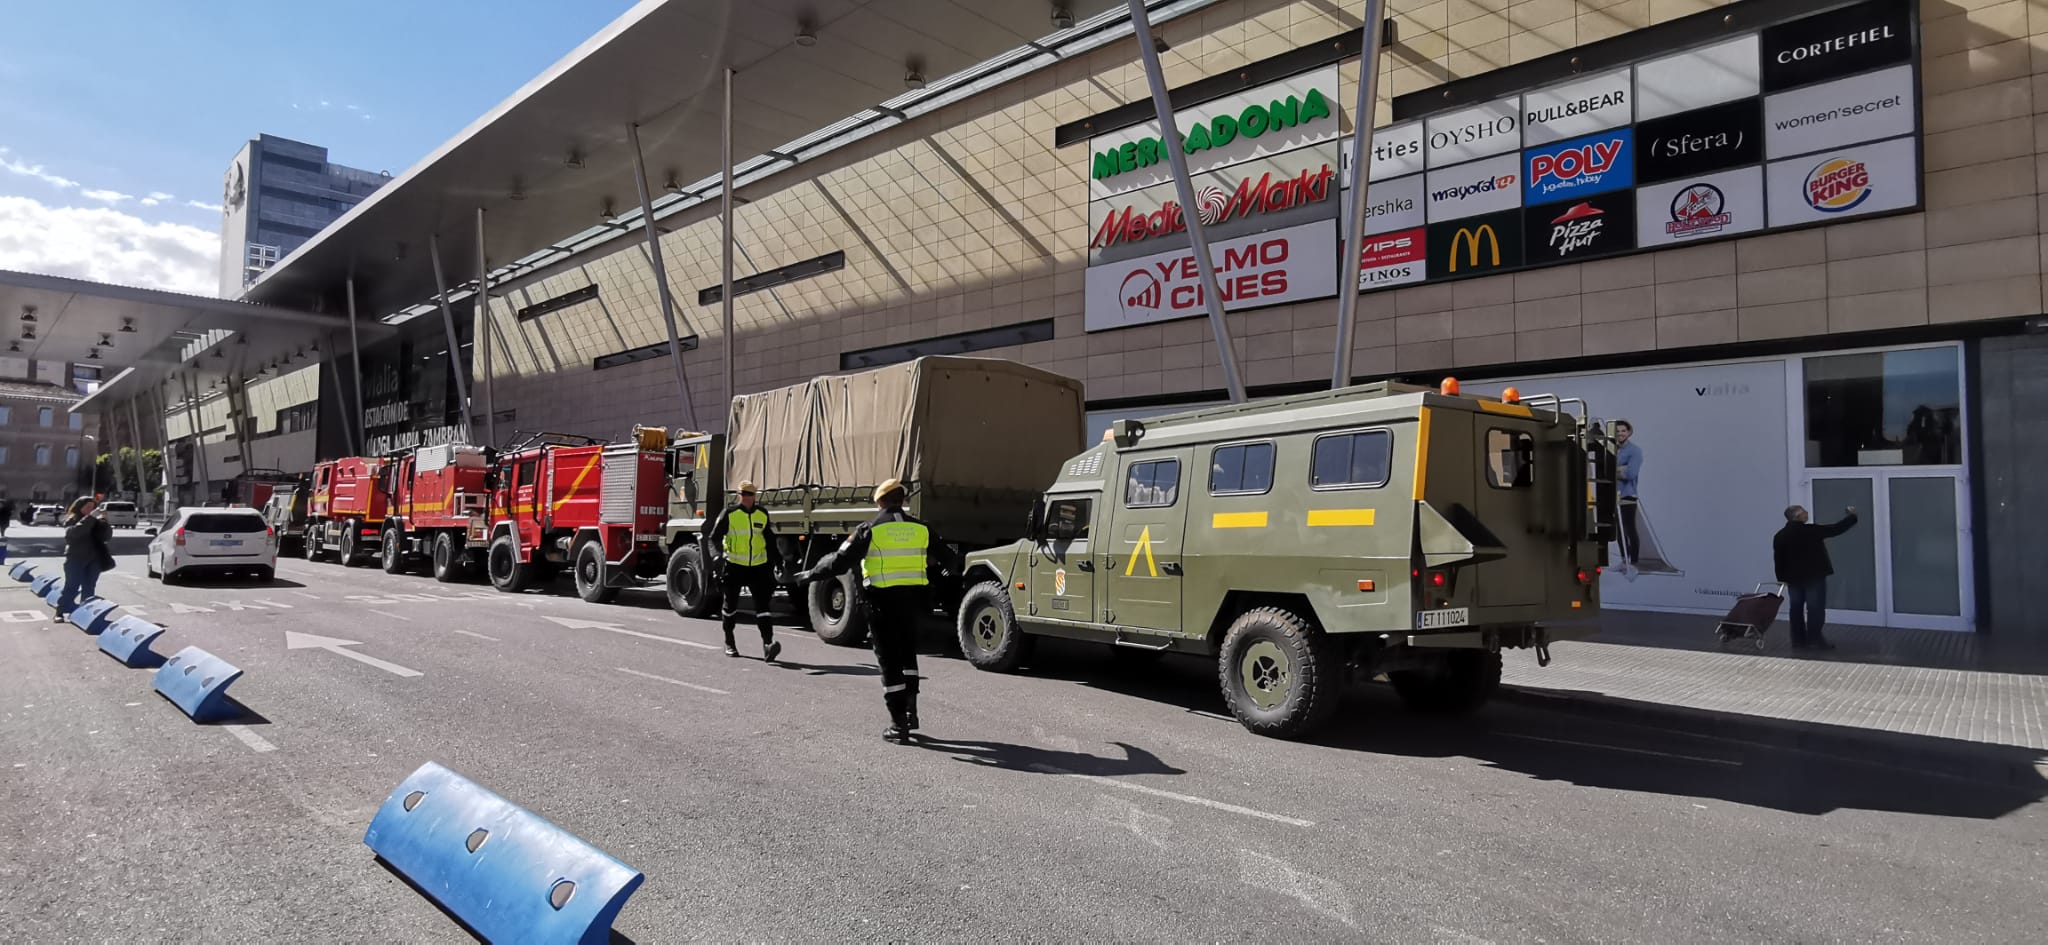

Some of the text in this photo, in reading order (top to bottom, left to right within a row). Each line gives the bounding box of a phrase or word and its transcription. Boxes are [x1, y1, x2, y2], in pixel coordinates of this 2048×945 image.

[1777, 25, 1895, 64] CORTEFIEL
[1527, 91, 1625, 126] PULL&BEAR
[1775, 94, 1902, 131] women'secret
[1431, 115, 1515, 150] OYSHO
[1666, 131, 1728, 157] Sfera
[1343, 140, 1419, 170] lties
[1531, 139, 1624, 188] POLY
[1220, 163, 1334, 222] Markt
[1432, 176, 1497, 202] mayoral
[1809, 162, 1866, 193] BURGER
[1812, 172, 1869, 206] KING
[1364, 197, 1414, 219] ershka
[1550, 218, 1604, 247] Pizza
[1558, 231, 1602, 257] Hut
[1155, 238, 1289, 282] YEMO
[398, 400, 410, 422] DE
[423, 423, 470, 447] ZAMBRAN
[1424, 610, 1465, 626] ET 111024
